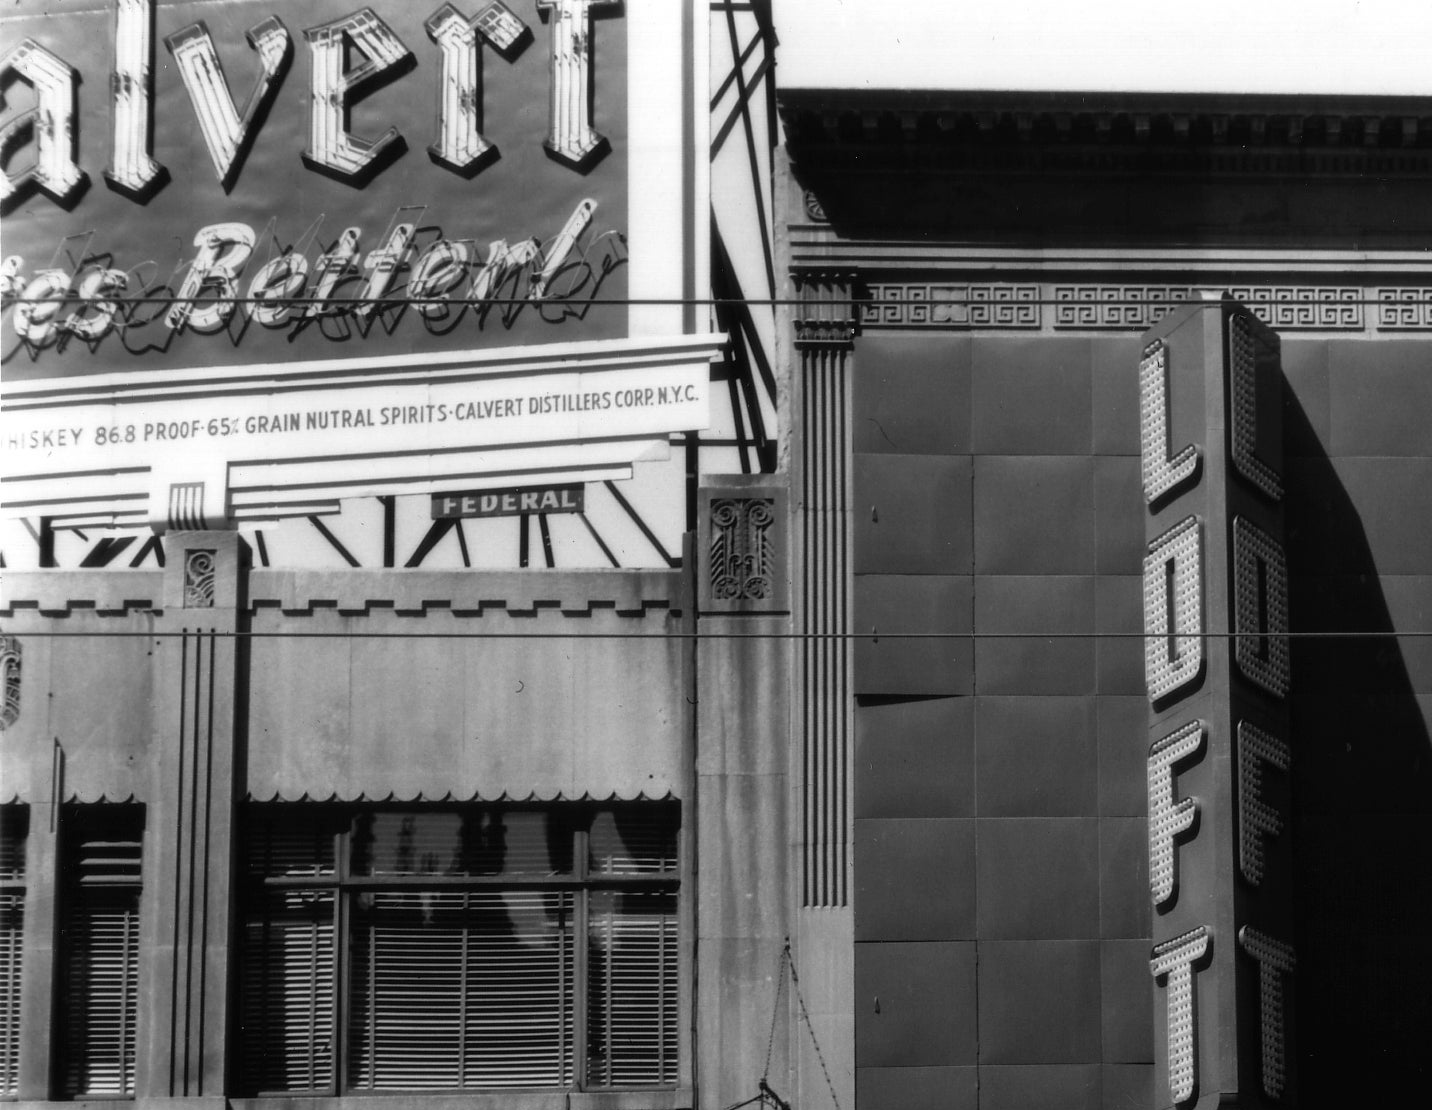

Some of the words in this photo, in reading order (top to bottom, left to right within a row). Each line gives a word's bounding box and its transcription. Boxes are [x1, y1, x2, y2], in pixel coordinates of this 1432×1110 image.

[0, 428, 83, 449] HISKEY
[95, 425, 136, 445] 86.8
[245, 412, 300, 434] GRAIN
[306, 408, 374, 429] NUTRAL
[380, 404, 447, 426] SPIRITS
[455, 398, 523, 421] CALVERT
[529, 391, 611, 415] DISTILLERS
[658, 384, 699, 405] N.Y.C.
[442, 489, 577, 515] FEDERAL
[1139, 337, 1209, 1105] LOFT
[1229, 311, 1297, 1103] LOFT
